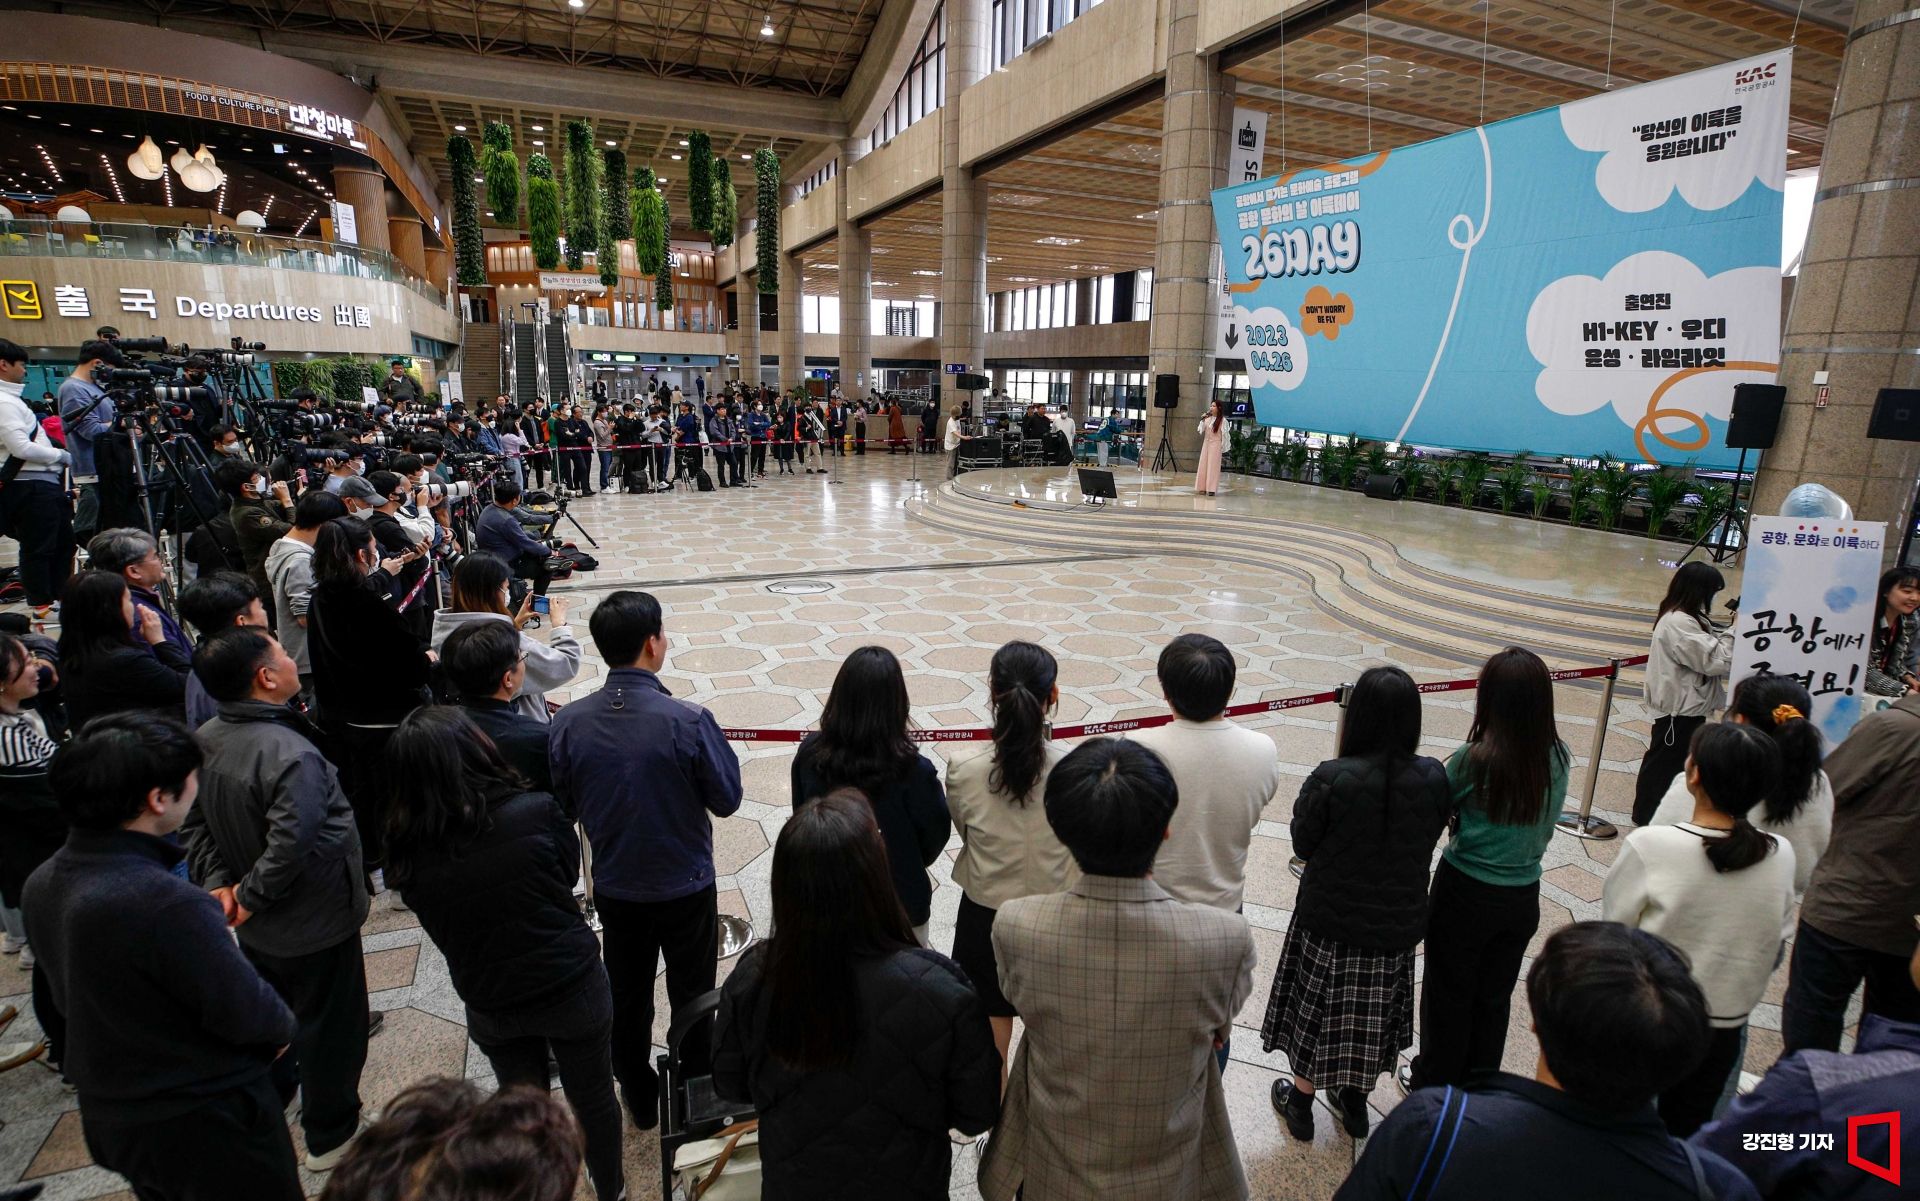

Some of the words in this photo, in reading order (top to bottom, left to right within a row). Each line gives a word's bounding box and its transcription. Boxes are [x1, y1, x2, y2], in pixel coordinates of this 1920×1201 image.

[1735, 62, 1777, 85] KAC
[1734, 79, 1776, 94] 한국공항공사
[186, 91, 209, 102] FOOD
[210, 95, 217, 103] &
[218, 97, 255, 111] CULTURE
[256, 104, 280, 116] PLACE
[288, 105, 355, 140] 대청마루
[1691, 105, 1742, 133] 이륙을
[1238, 209, 1259, 231] 공항
[1260, 202, 1294, 227] 문화의
[1295, 200, 1308, 220] 날
[1310, 190, 1360, 218] 이륙데이
[1241, 220, 1361, 281] 26DAY
[175, 295, 323, 323] Departures
[334, 304, 372, 328] 出國
[1306, 305, 1323, 314] DON'T
[1323, 304, 1346, 314] WORRY
[1625, 293, 1671, 311] 출연진
[1317, 315, 1326, 324] BE
[1326, 315, 1336, 324] FLY
[1583, 320, 1659, 342] H1-KEY
[1681, 318, 1726, 341] 우디
[1245, 324, 1289, 347] 2023
[1250, 350, 1294, 373] 04.26
[1641, 347, 1726, 369] 라임라잇
[1793, 533, 1830, 548] 문화로
[1833, 536, 1880, 550] 이륙하다
[1742, 610, 1865, 655] 공항에서
[1268, 700, 1288, 711] KAC
[723, 731, 757, 739] 국공항공사
[936, 732, 973, 740] 한국공항공사
[1083, 723, 1107, 735] KAC
